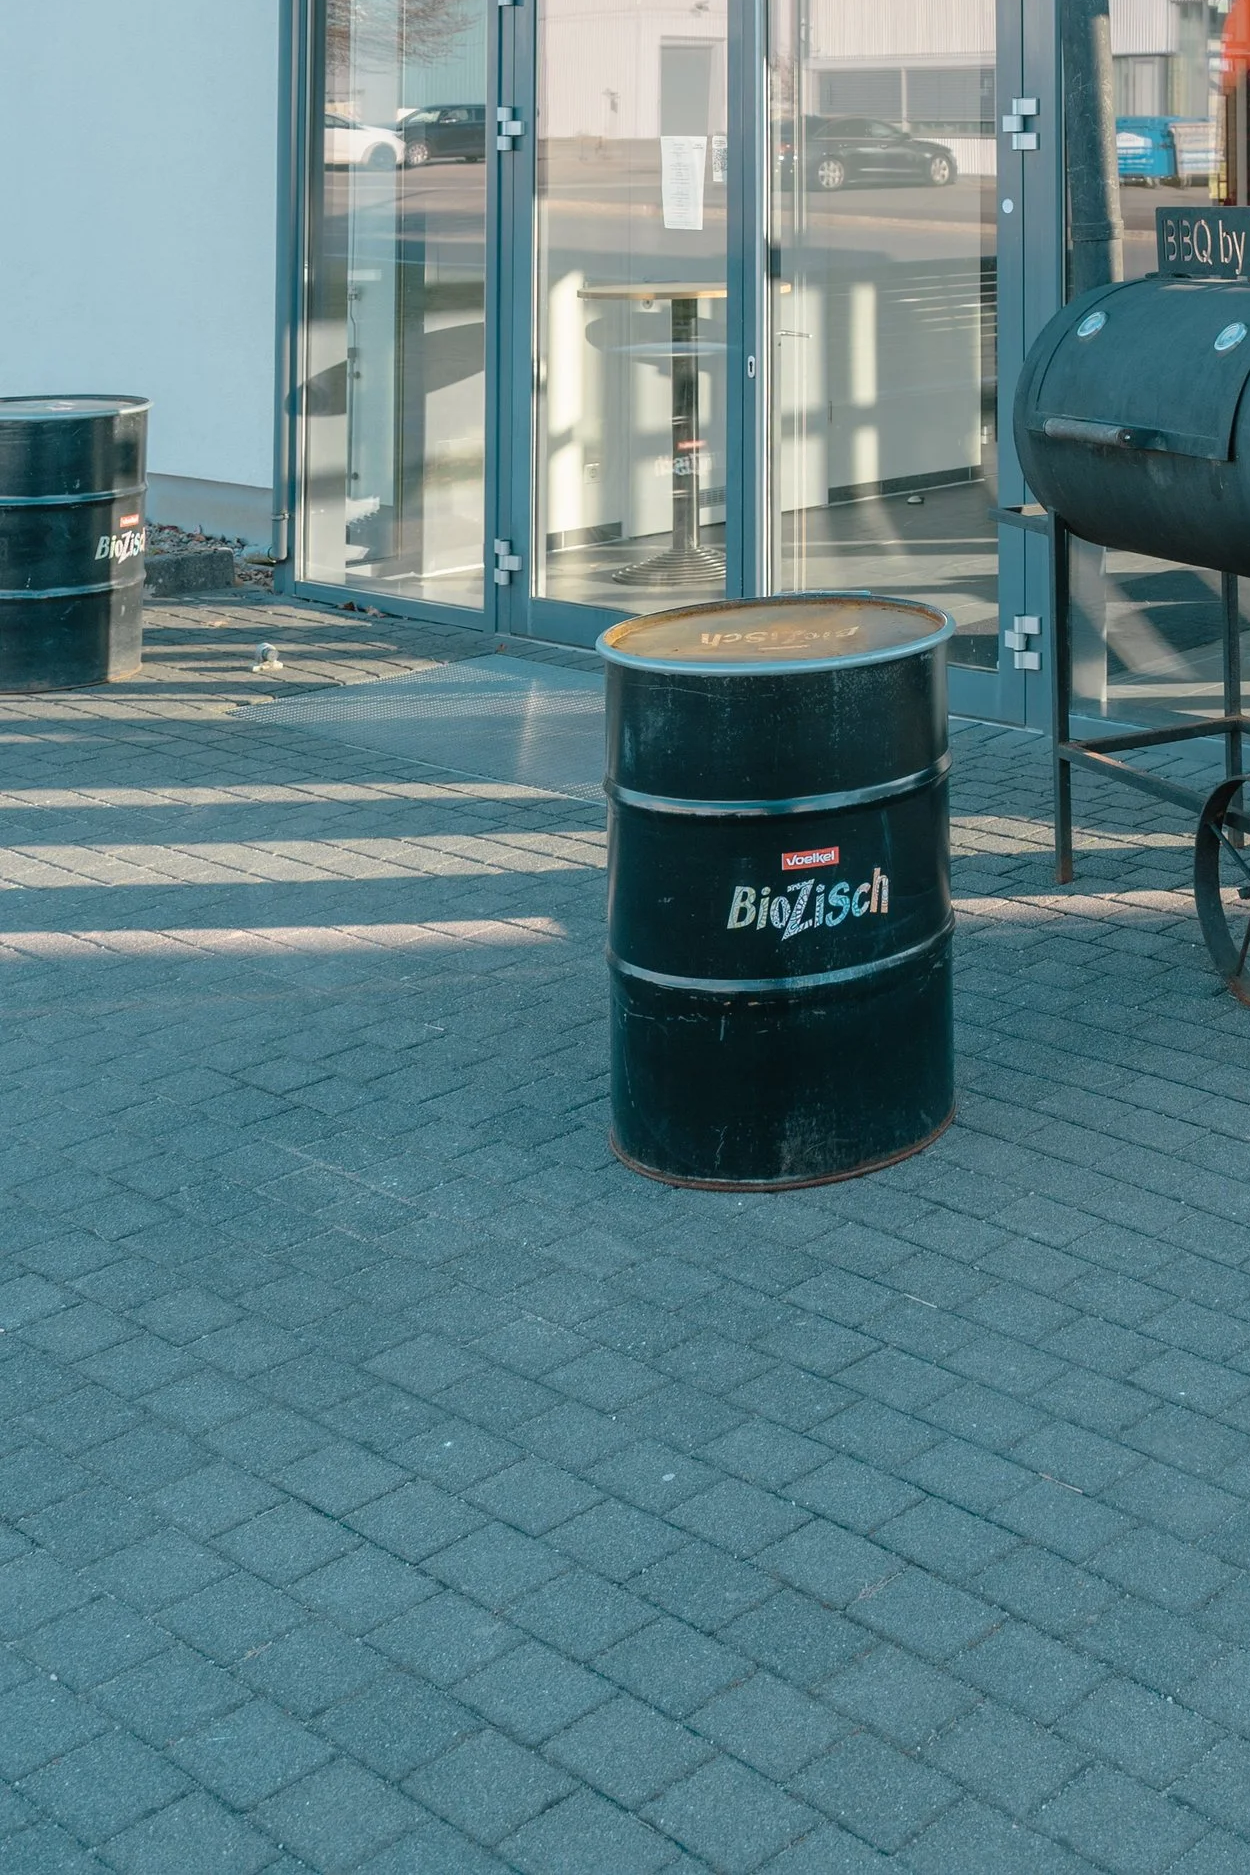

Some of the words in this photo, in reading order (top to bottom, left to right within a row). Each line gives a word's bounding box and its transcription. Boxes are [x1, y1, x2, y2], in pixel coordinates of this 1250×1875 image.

[1163, 219, 1213, 265] BBQ
[1219, 219, 1246, 275] by
[786, 849, 835, 867] Voelkel
[726, 867, 889, 941] BioZisch
